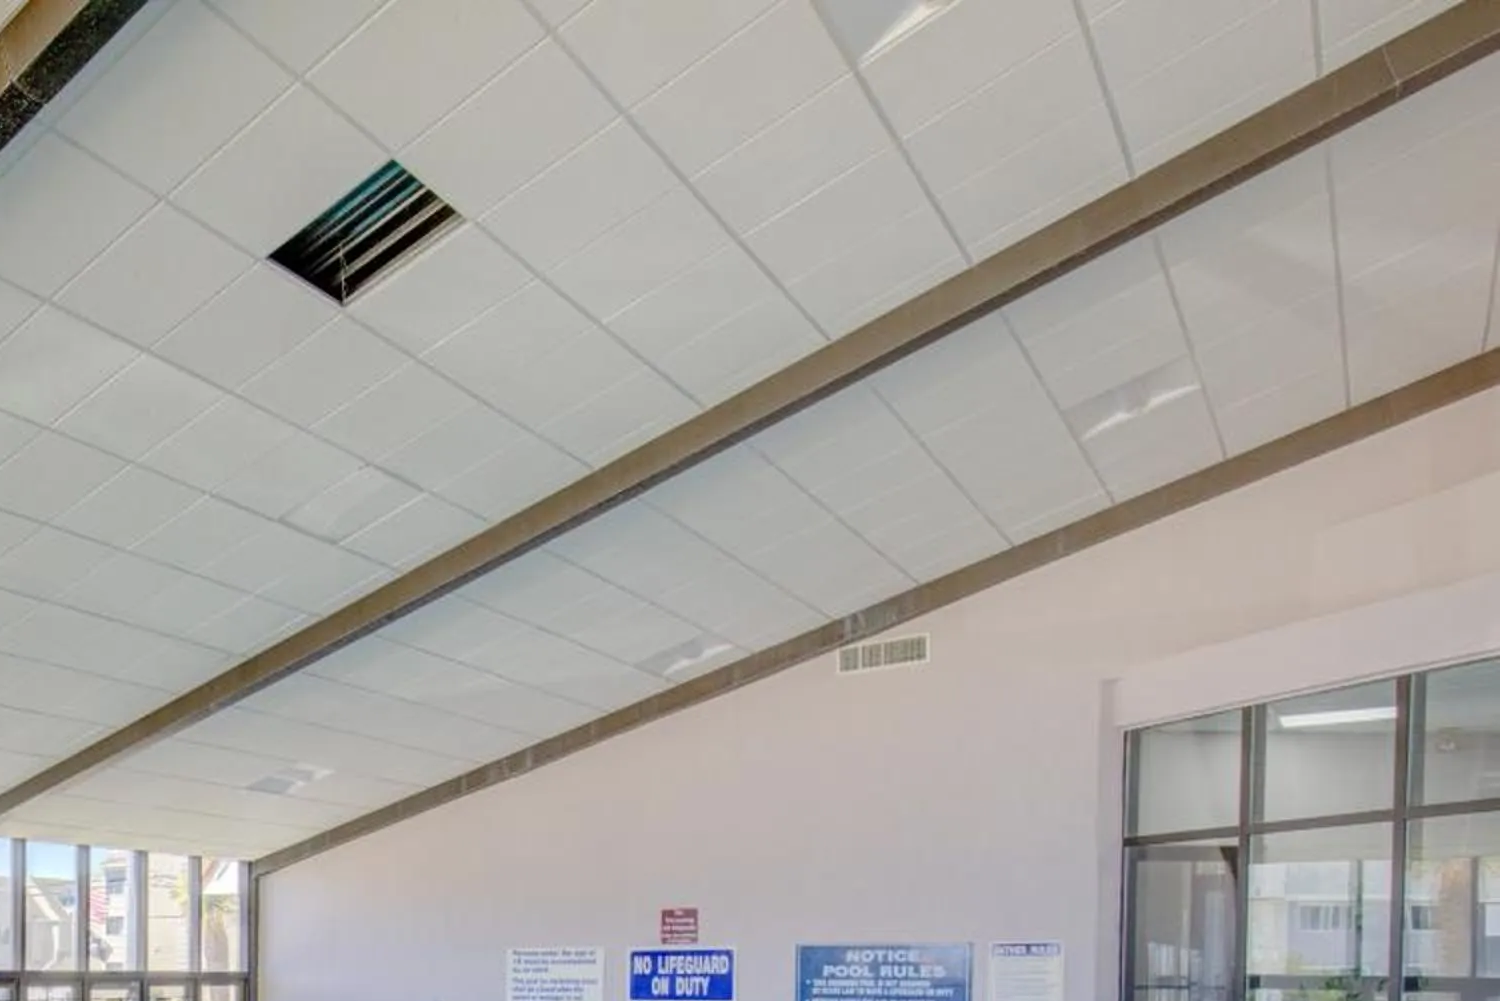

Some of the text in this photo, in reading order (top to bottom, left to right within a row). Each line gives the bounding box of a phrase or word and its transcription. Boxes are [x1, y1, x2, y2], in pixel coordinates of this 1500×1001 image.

[633, 954, 729, 975] NO LIFEGUARD
[846, 949, 920, 963] NOTICE
[822, 964, 946, 979] POOL RULES
[651, 976, 711, 997] ON DUTY
